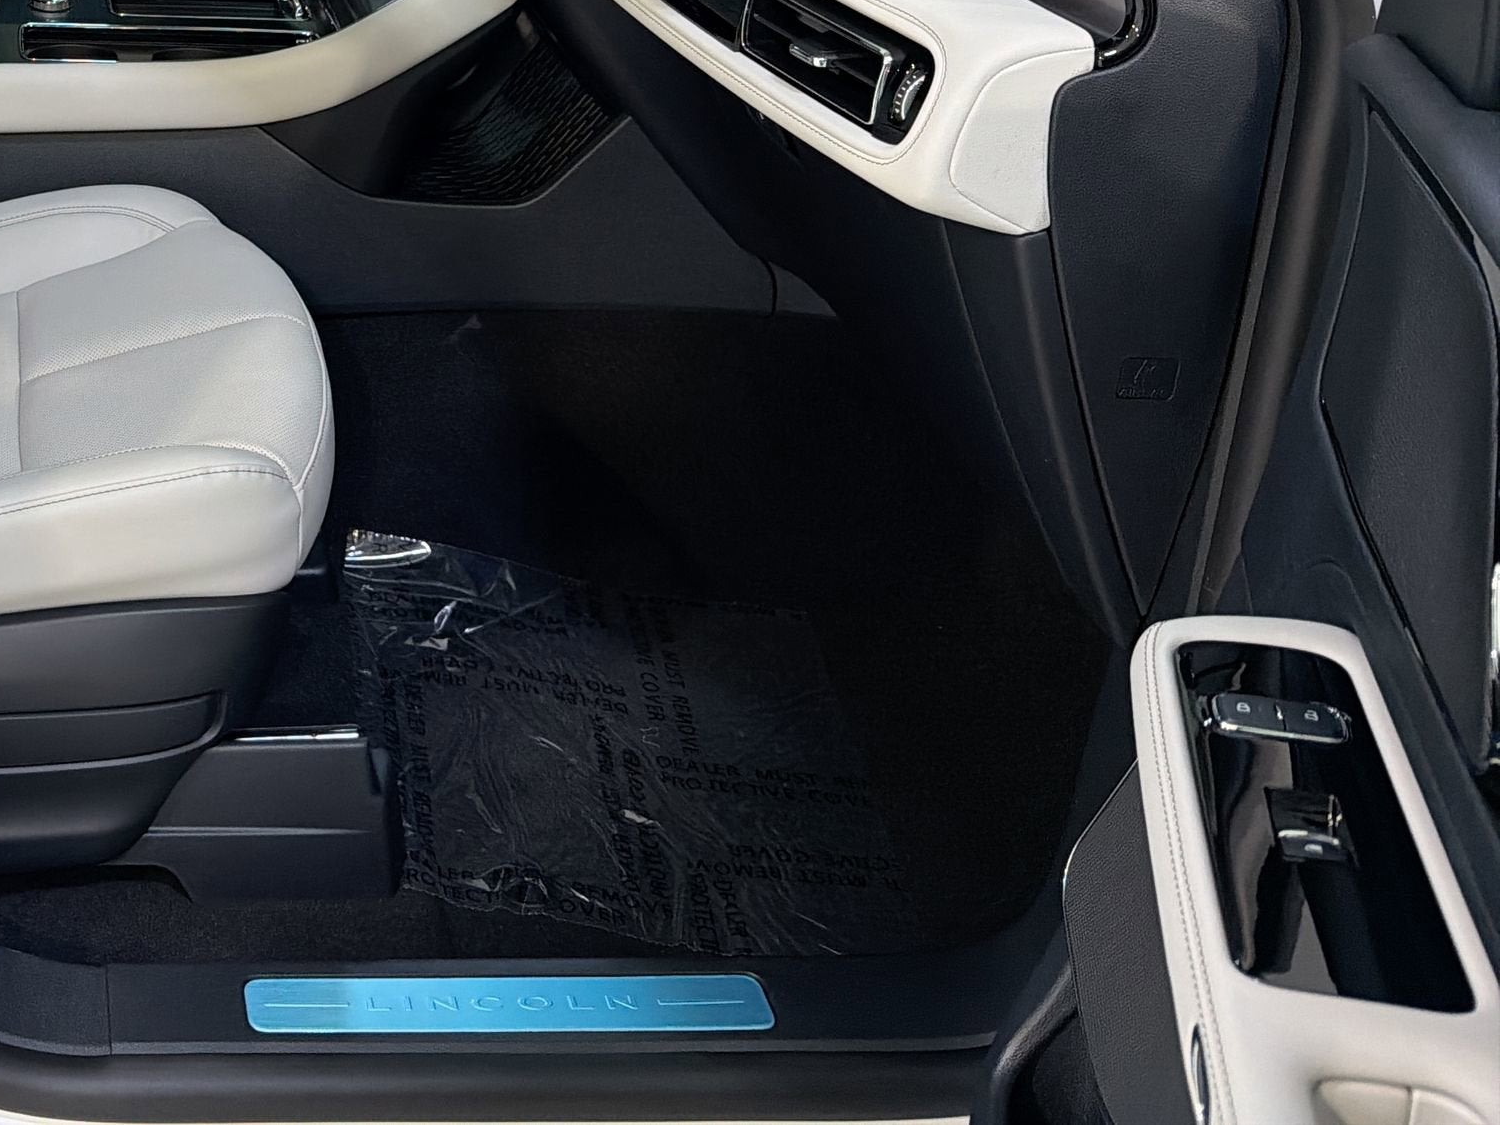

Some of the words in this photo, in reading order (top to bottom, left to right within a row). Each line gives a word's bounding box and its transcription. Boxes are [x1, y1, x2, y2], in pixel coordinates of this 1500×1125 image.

[639, 671, 666, 722] COVER
[672, 695, 700, 757] REMOVE
[655, 755, 742, 777] DEALER
[755, 768, 819, 787] MUST
[363, 992, 640, 1013] LINCOLN
